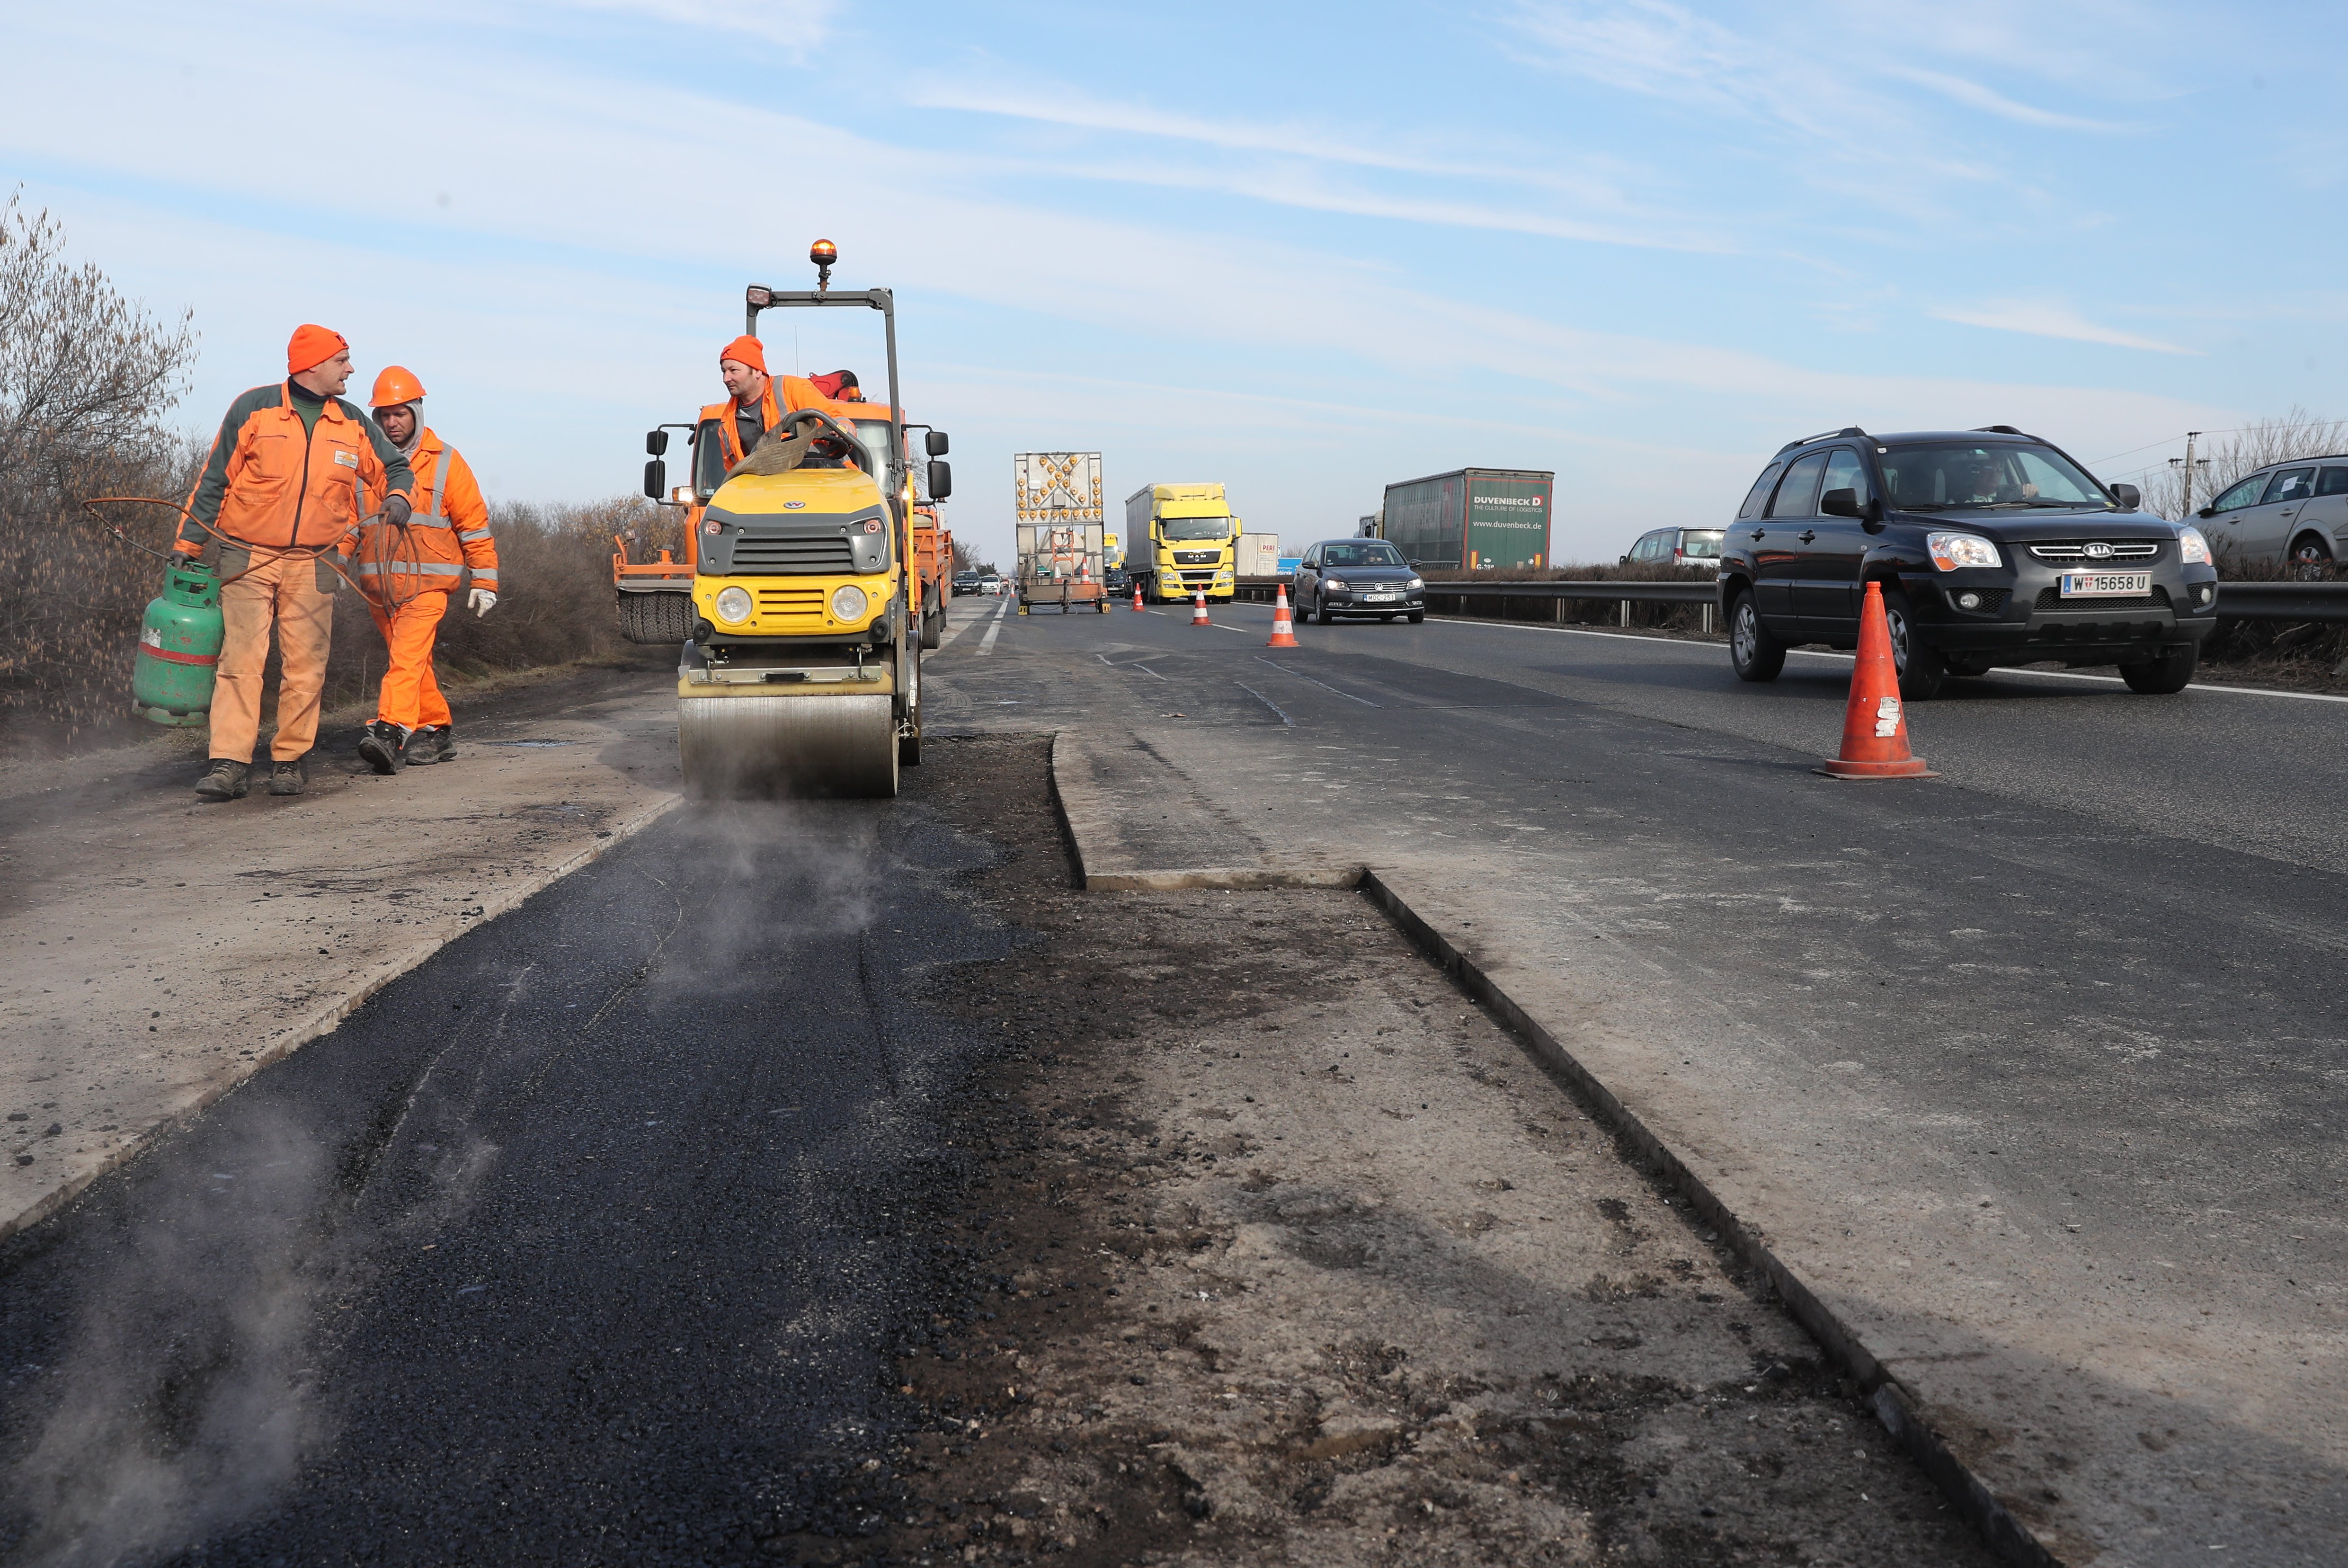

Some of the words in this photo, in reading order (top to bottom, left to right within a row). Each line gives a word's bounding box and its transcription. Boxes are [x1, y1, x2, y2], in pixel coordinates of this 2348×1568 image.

[1474, 496, 1530, 506] DUVENBECK
[1532, 497, 1541, 506] D
[1473, 521, 1542, 530] www.duvenbeck.de
[2088, 545, 2110, 555] KIA
[2074, 577, 2084, 590] W
[2094, 576, 2134, 590] 15658
[2137, 576, 2145, 589] U
